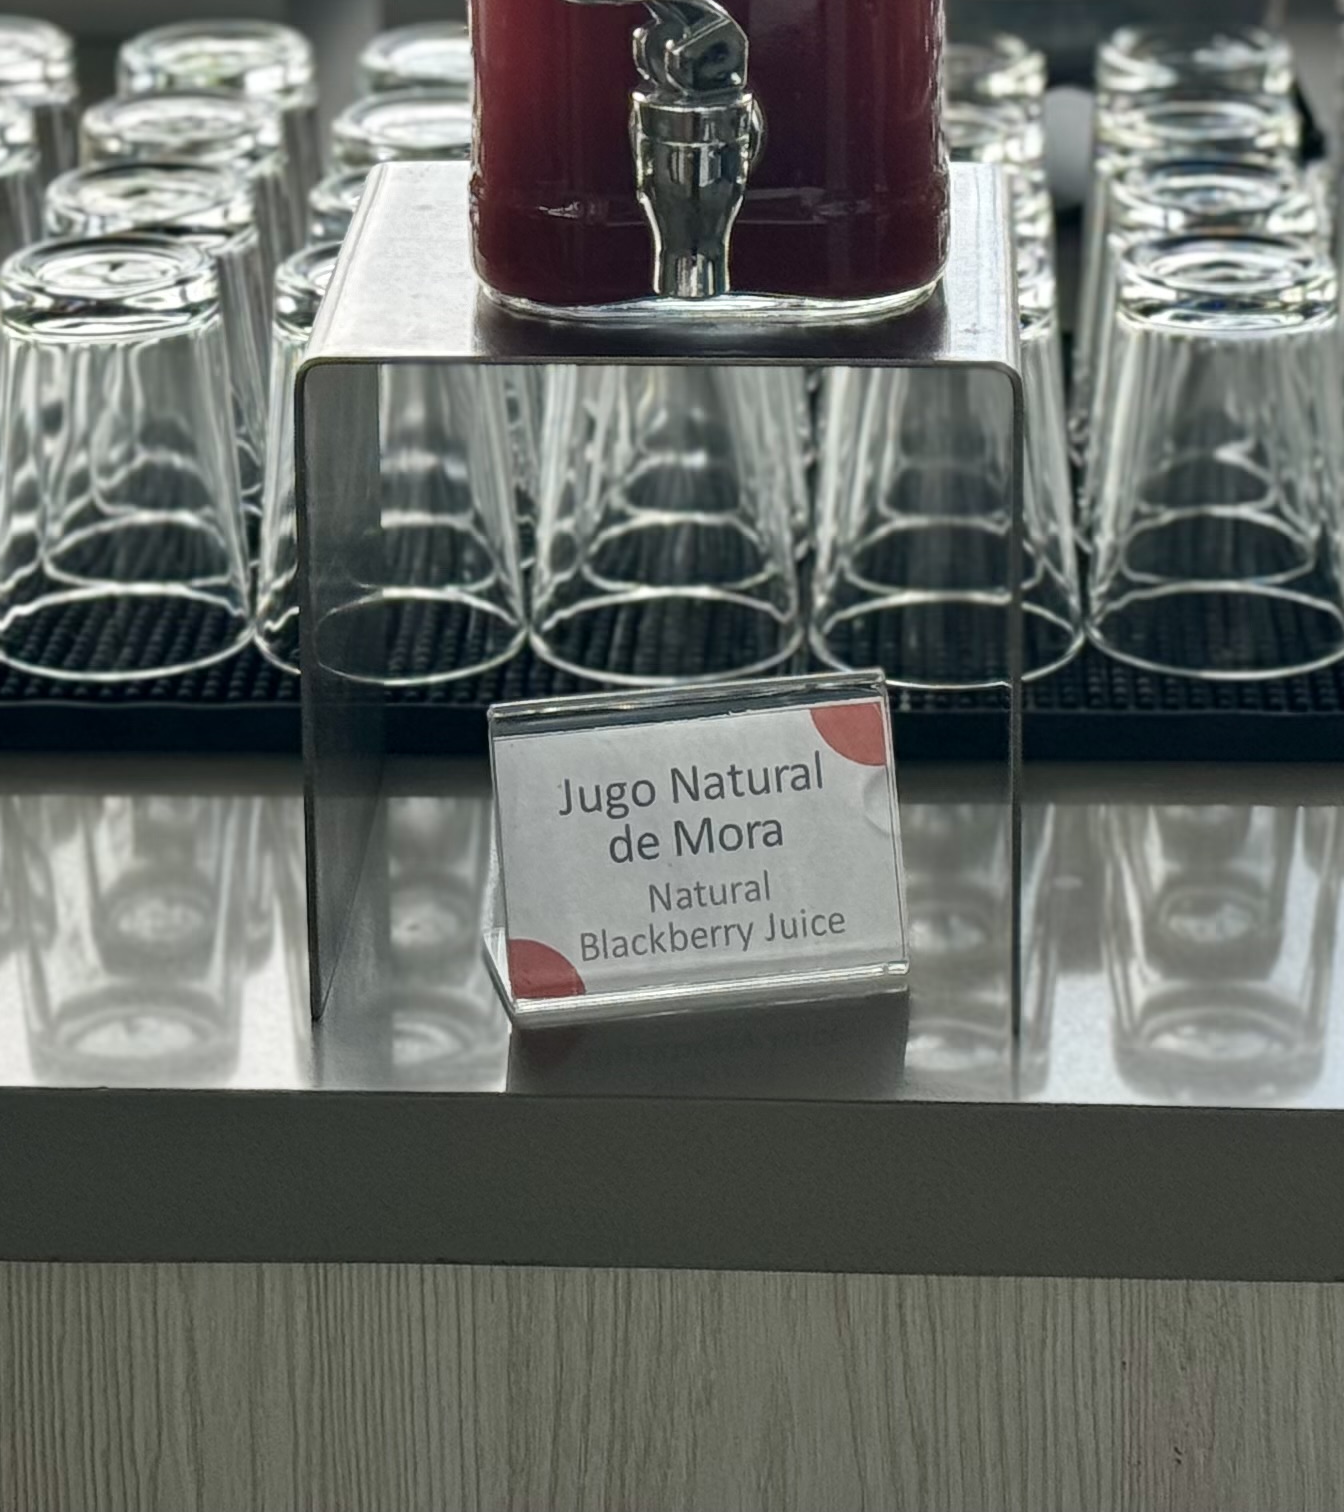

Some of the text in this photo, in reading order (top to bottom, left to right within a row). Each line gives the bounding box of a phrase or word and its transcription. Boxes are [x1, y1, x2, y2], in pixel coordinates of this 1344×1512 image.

[558, 750, 824, 819] Jugo Natural
[609, 817, 784, 864] de Mora
[648, 870, 771, 913] Natural
[580, 910, 846, 962] Blackberry Juice
